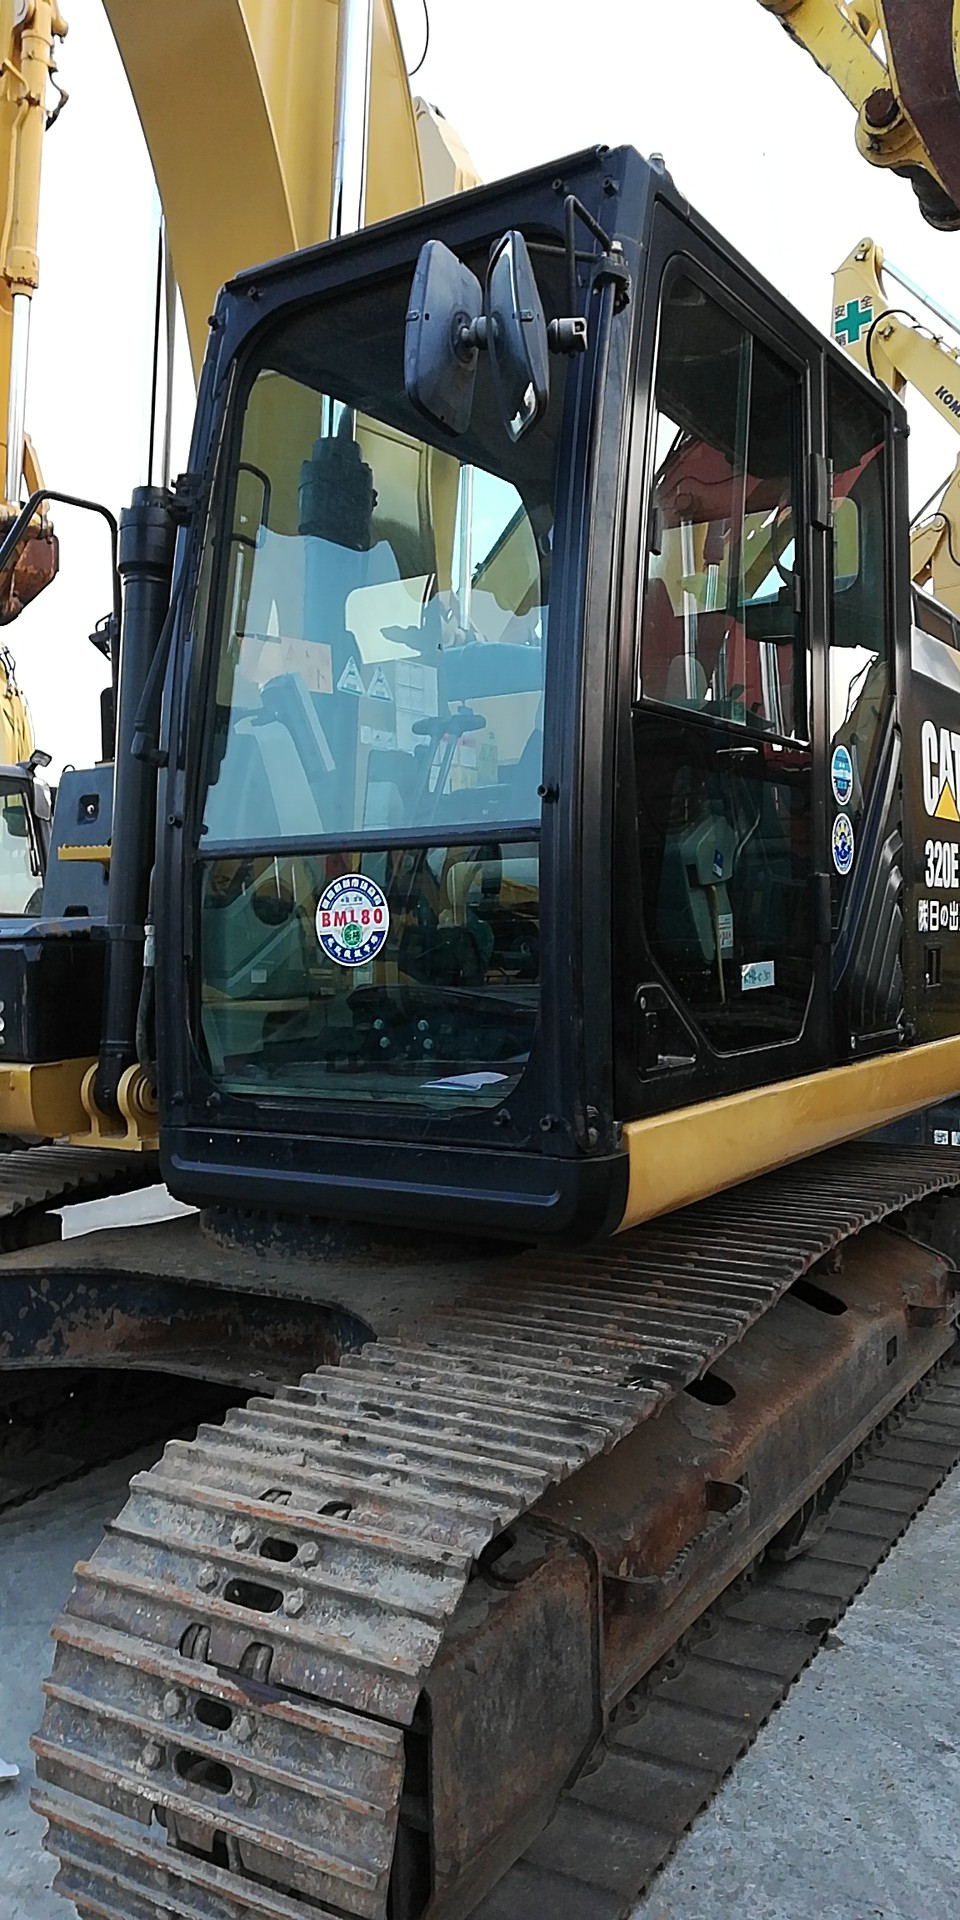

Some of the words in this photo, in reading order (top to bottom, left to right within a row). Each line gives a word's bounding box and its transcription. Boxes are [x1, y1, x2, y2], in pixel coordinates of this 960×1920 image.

[934, 385, 960, 418] KOM
[921, 719, 960, 817] CAT
[924, 838, 960, 889] 320E
[321, 908, 383, 927] BML80
